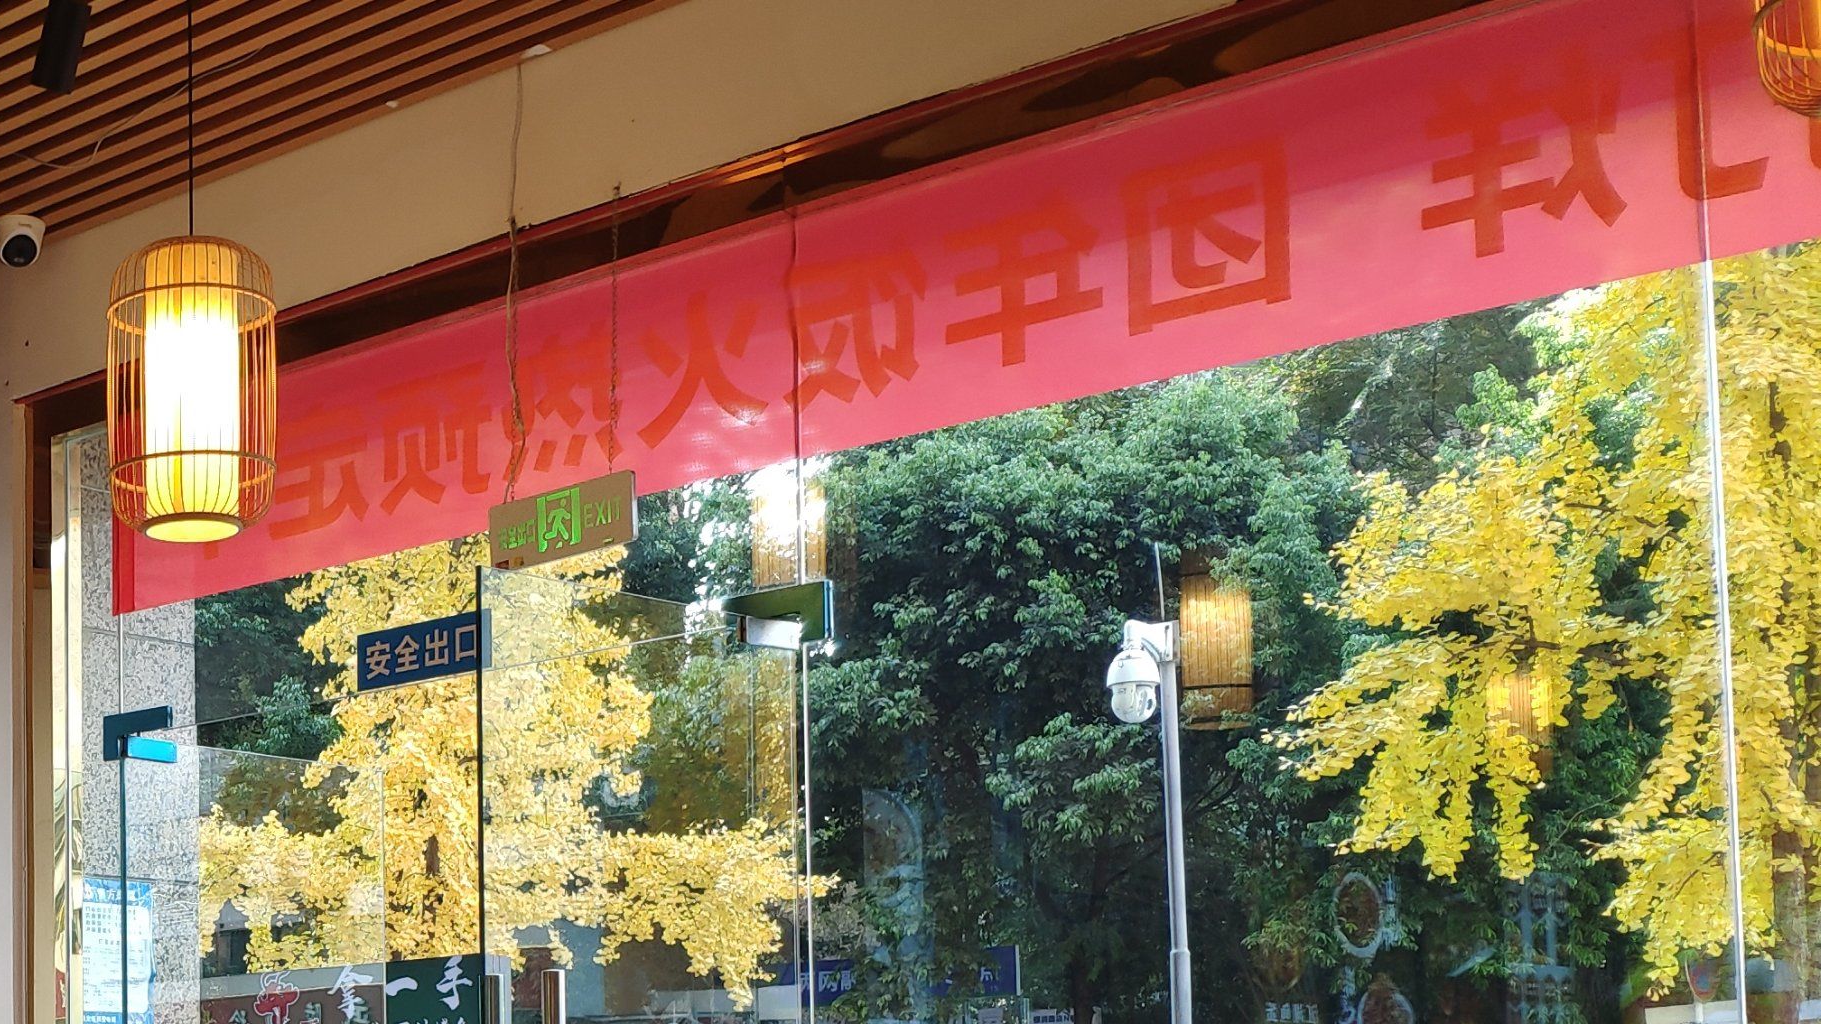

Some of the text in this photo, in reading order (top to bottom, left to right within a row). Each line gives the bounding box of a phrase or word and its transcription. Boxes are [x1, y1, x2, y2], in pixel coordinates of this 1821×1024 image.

[583, 498, 621, 529] EXIT
[364, 626, 478, 679] 安全出口
[328, 955, 473, 1019] 拿一手
